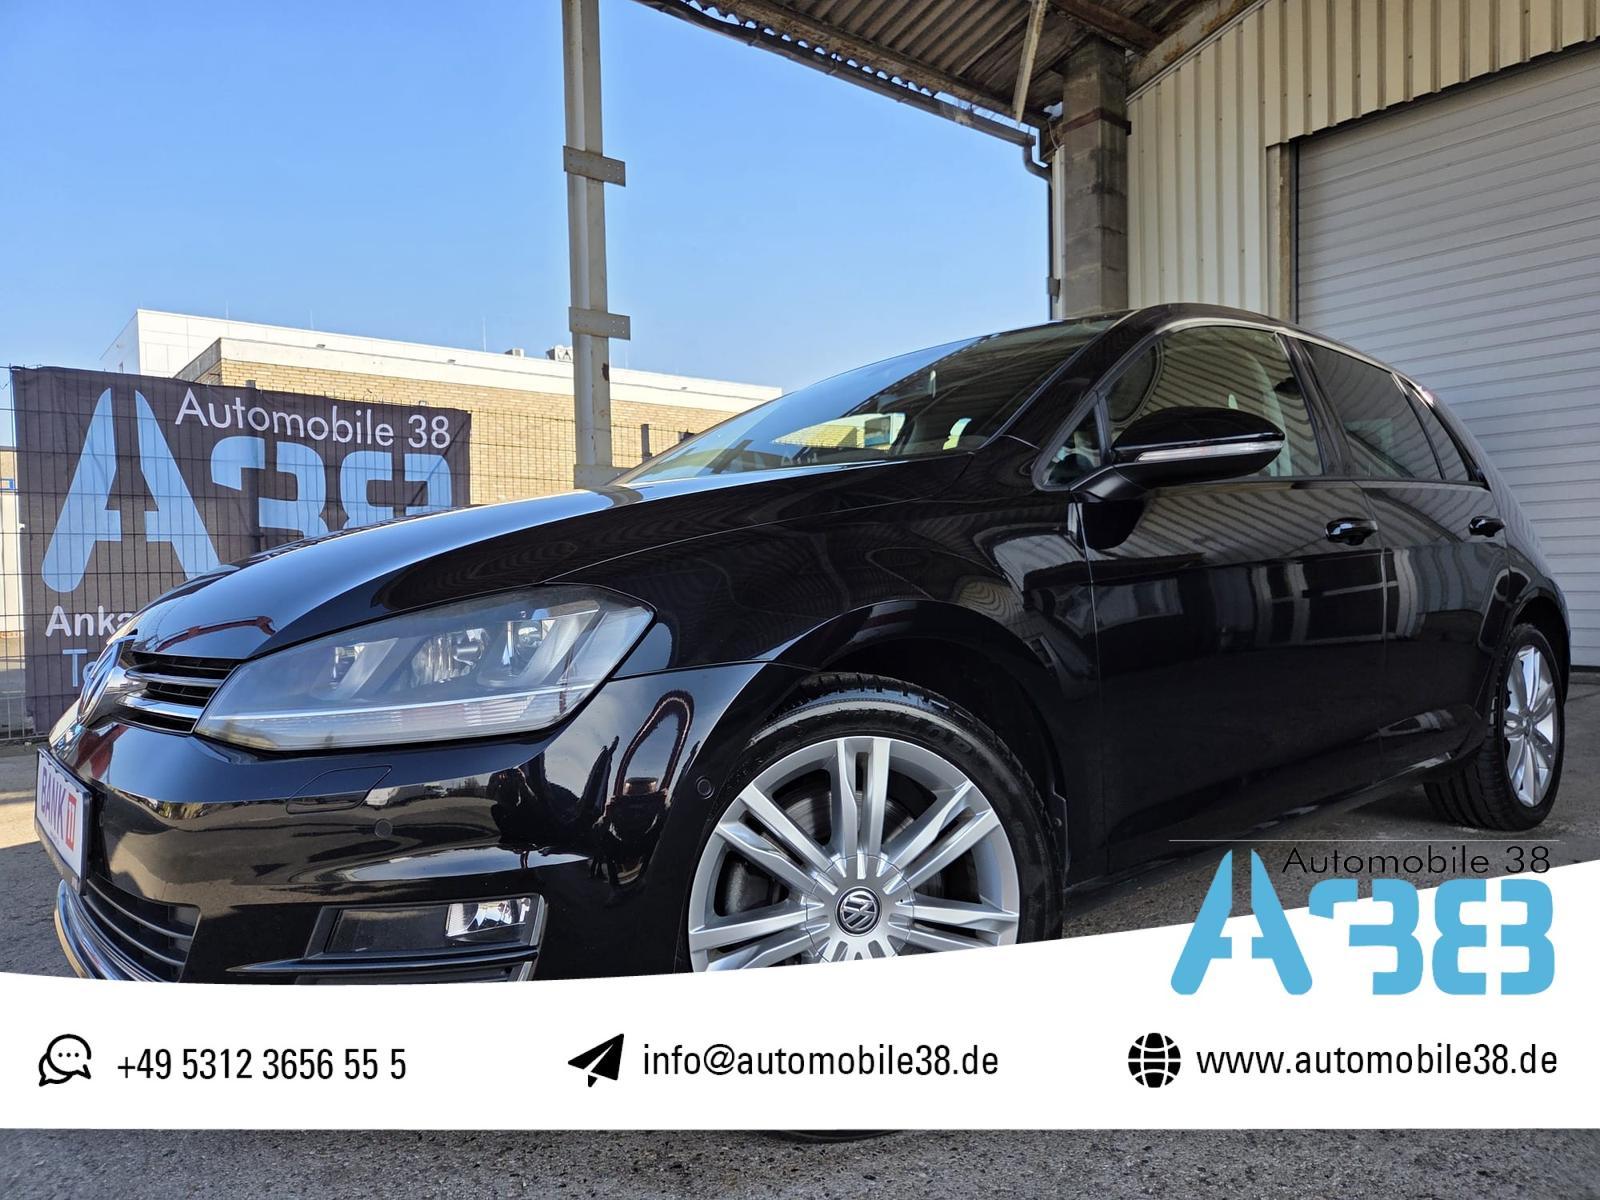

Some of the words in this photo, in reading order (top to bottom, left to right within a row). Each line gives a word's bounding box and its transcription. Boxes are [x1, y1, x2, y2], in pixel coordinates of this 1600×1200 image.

[175, 388, 394, 447] Automobile
[407, 415, 451, 449] 38
[41, 766, 67, 841] BANK
